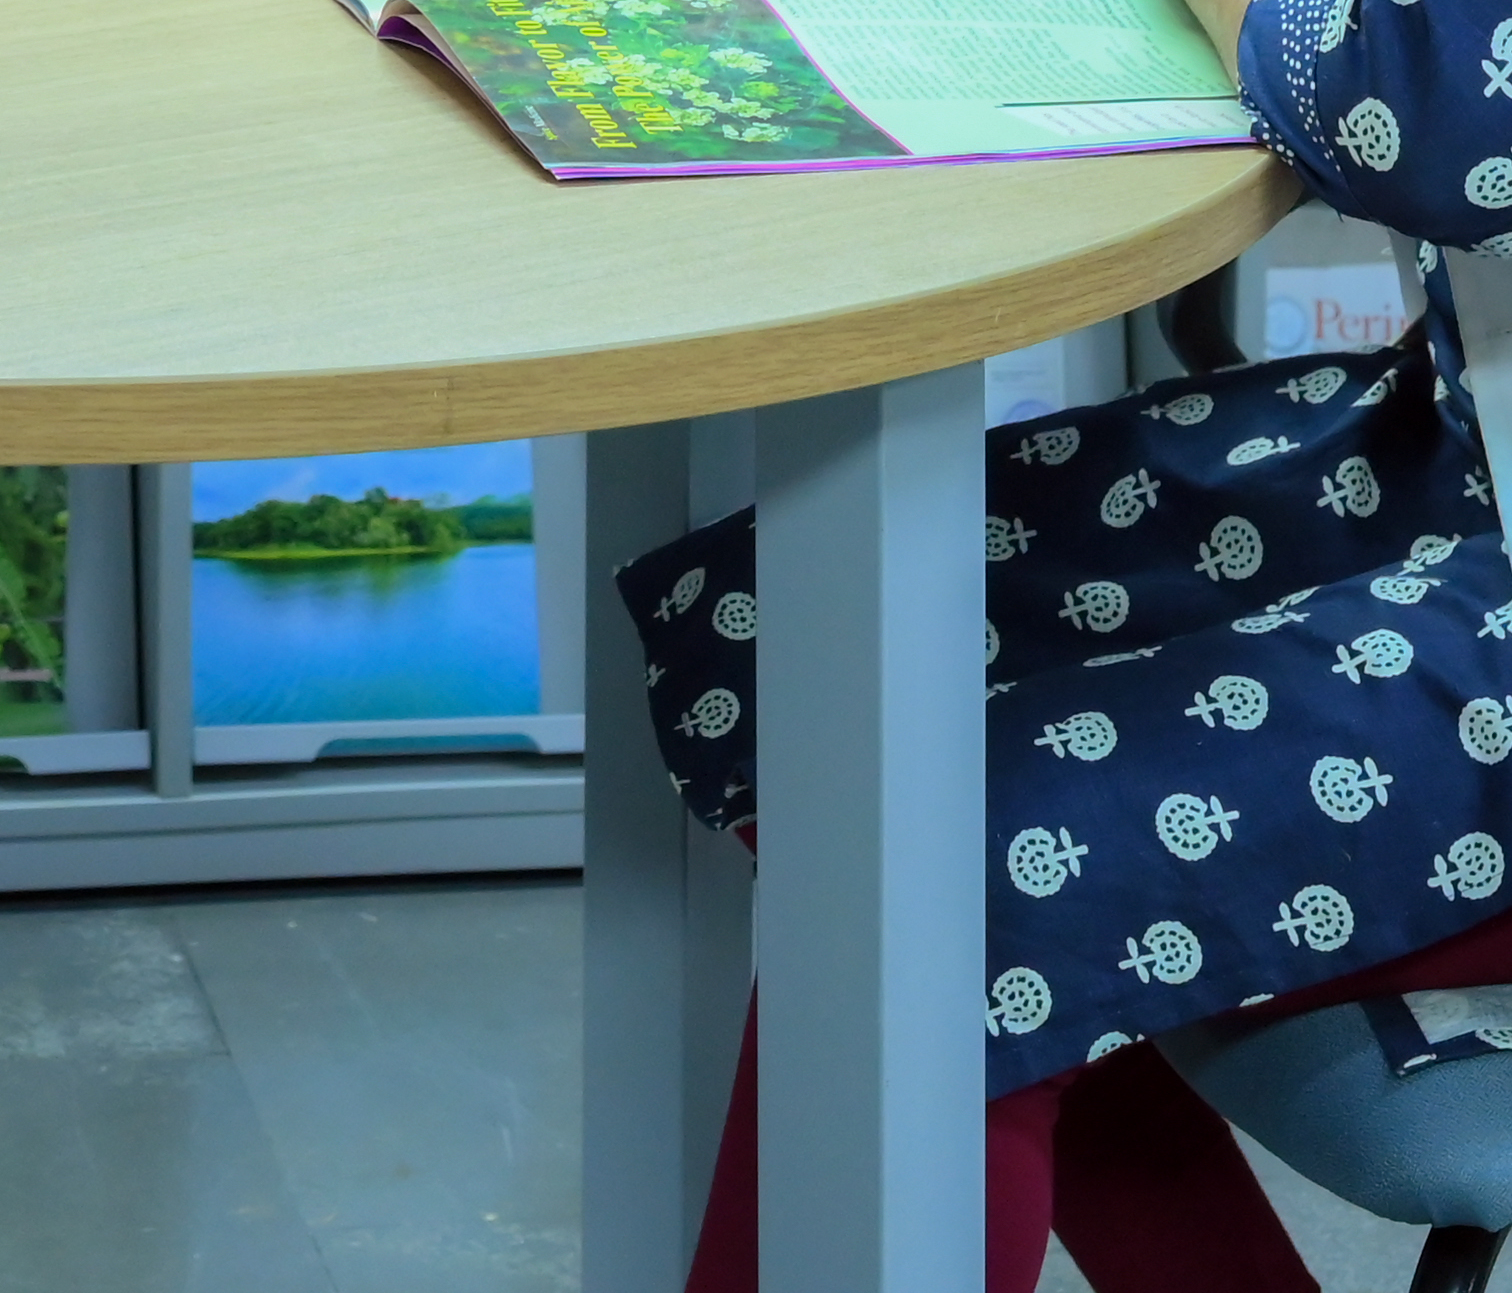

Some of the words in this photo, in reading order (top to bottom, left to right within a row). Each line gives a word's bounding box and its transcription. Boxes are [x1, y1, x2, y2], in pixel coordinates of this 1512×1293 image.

[515, 20, 548, 35] to
[563, 20, 607, 37] of
[588, 40, 653, 97] Power
[575, 103, 638, 149] From
[636, 101, 683, 135] The
